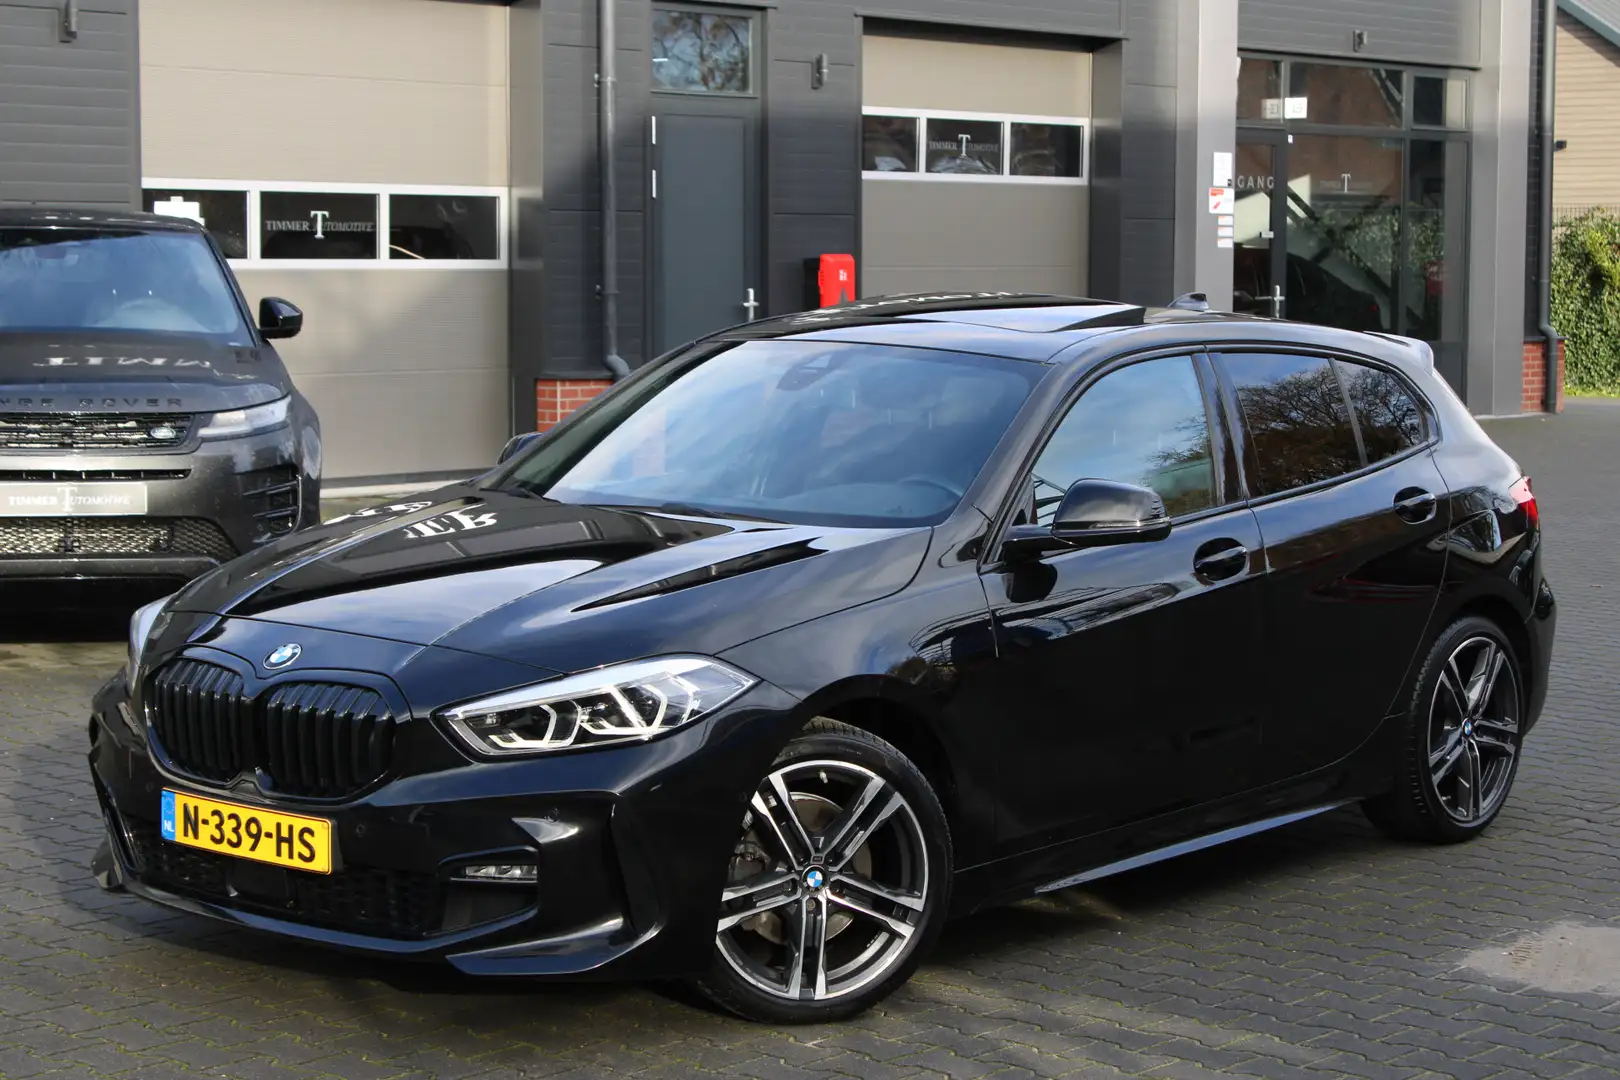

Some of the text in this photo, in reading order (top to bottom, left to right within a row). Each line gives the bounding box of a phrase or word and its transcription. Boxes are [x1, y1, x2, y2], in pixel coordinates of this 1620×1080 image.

[265, 220, 310, 231] TIMMER
[314, 221, 375, 232] UTOMOTIVE
[79, 398, 182, 407] ROVER
[8, 496, 58, 505] TIMMER
[163, 819, 175, 832] NL
[183, 802, 316, 863] N-339-HS
